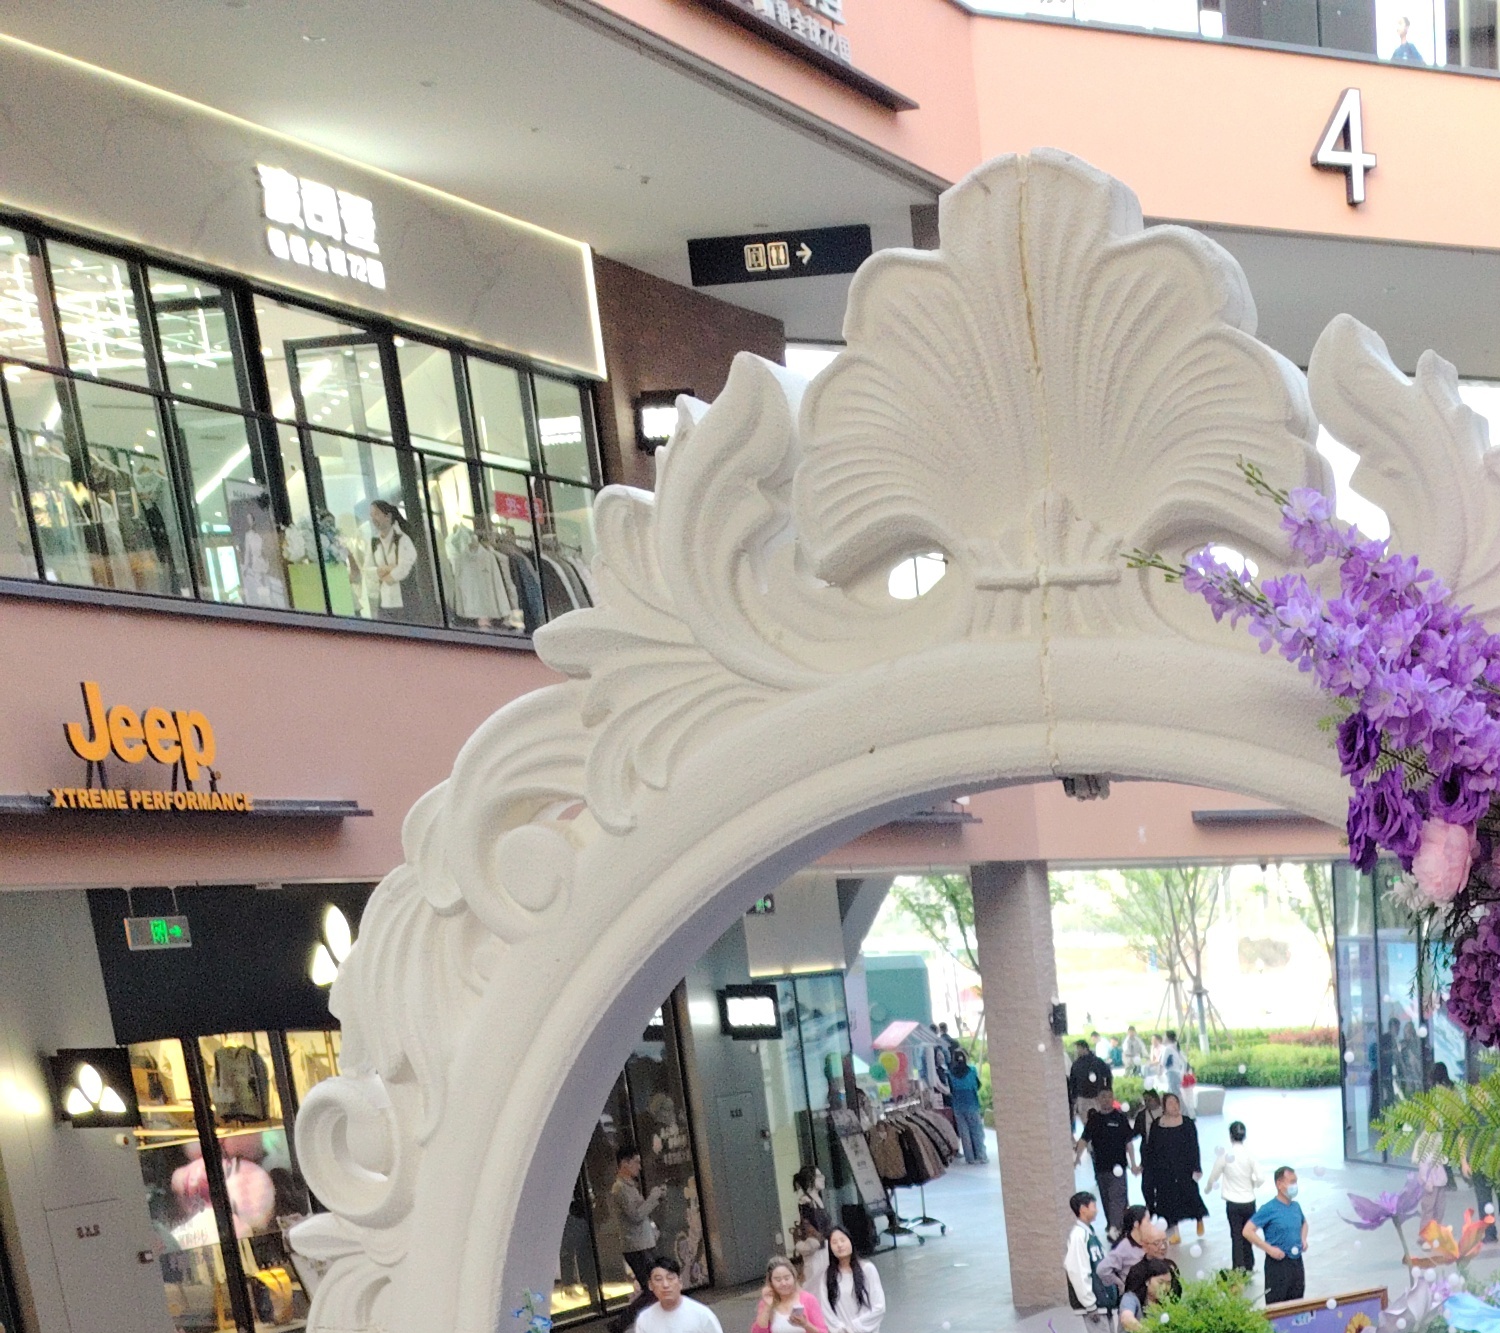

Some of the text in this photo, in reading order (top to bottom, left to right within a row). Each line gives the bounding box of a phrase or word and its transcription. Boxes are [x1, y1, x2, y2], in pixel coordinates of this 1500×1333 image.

[1311, 87, 1377, 206] 4
[64, 681, 216, 781] Jeep
[51, 787, 254, 812] XTREME PERFORMANCE
